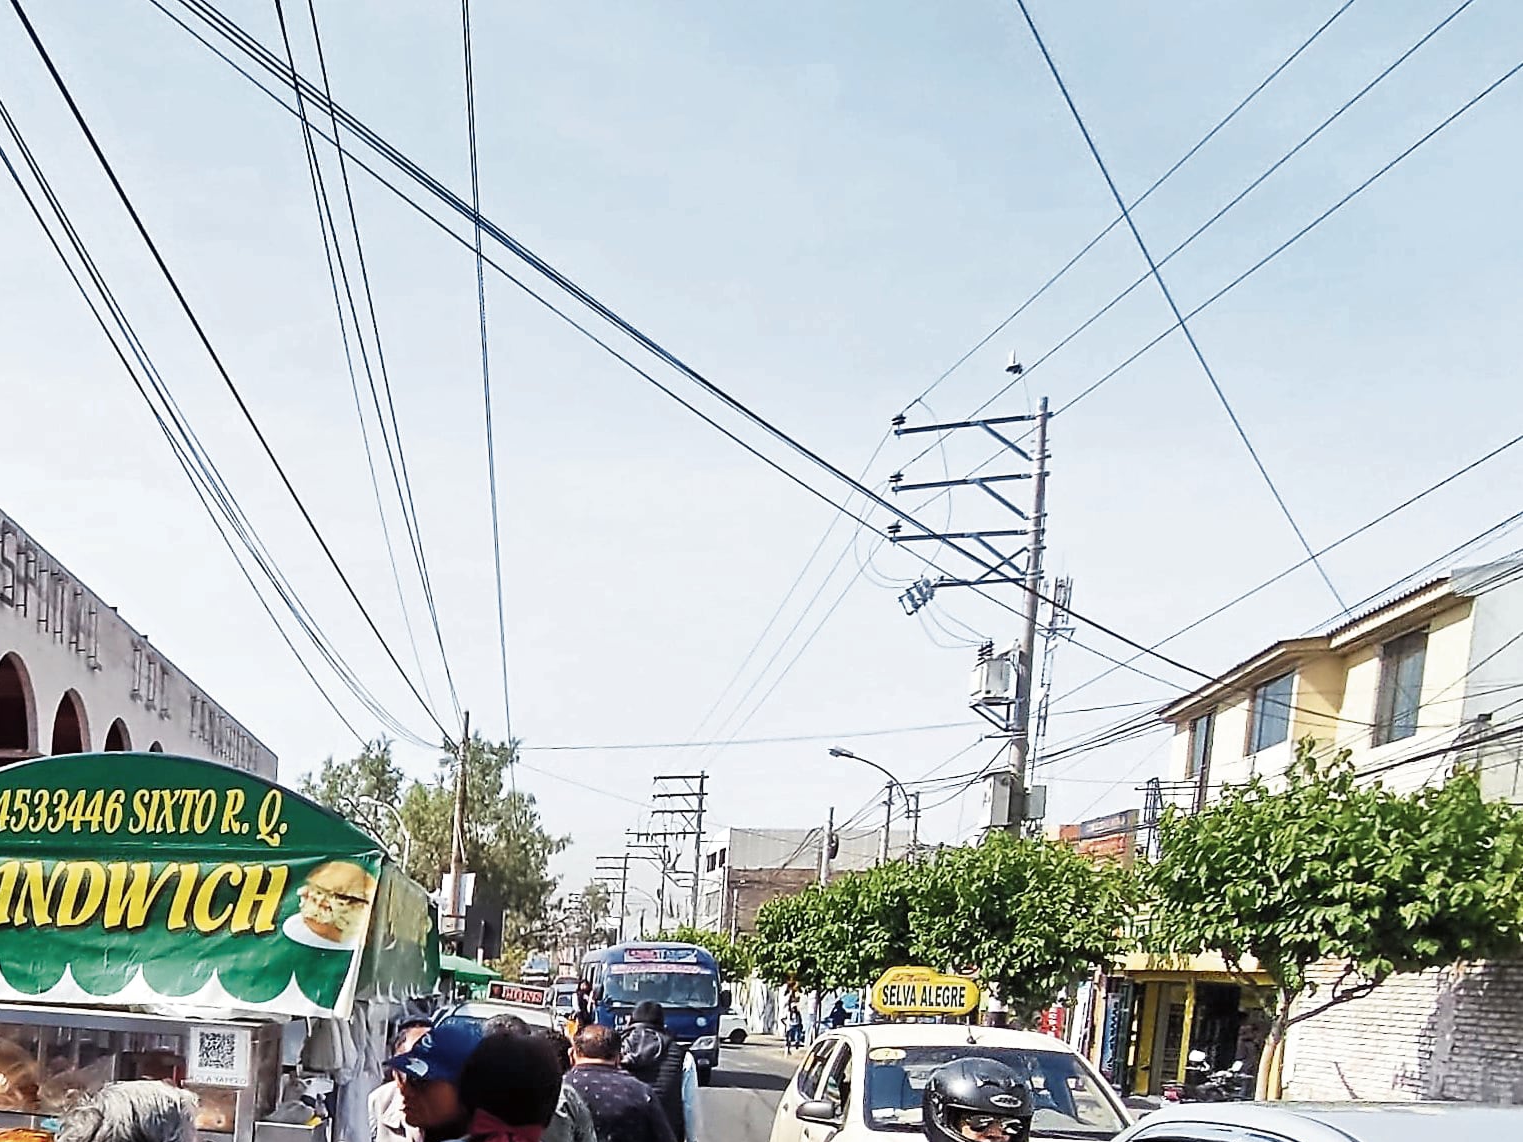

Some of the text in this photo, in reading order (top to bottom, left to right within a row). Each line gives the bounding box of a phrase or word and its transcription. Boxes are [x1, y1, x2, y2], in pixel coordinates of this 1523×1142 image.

[129, 789, 217, 834] SIXTO
[221, 789, 250, 835] R.
[256, 789, 289, 847] Q.
[882, 985, 966, 1008] SELVA ALEGRE
